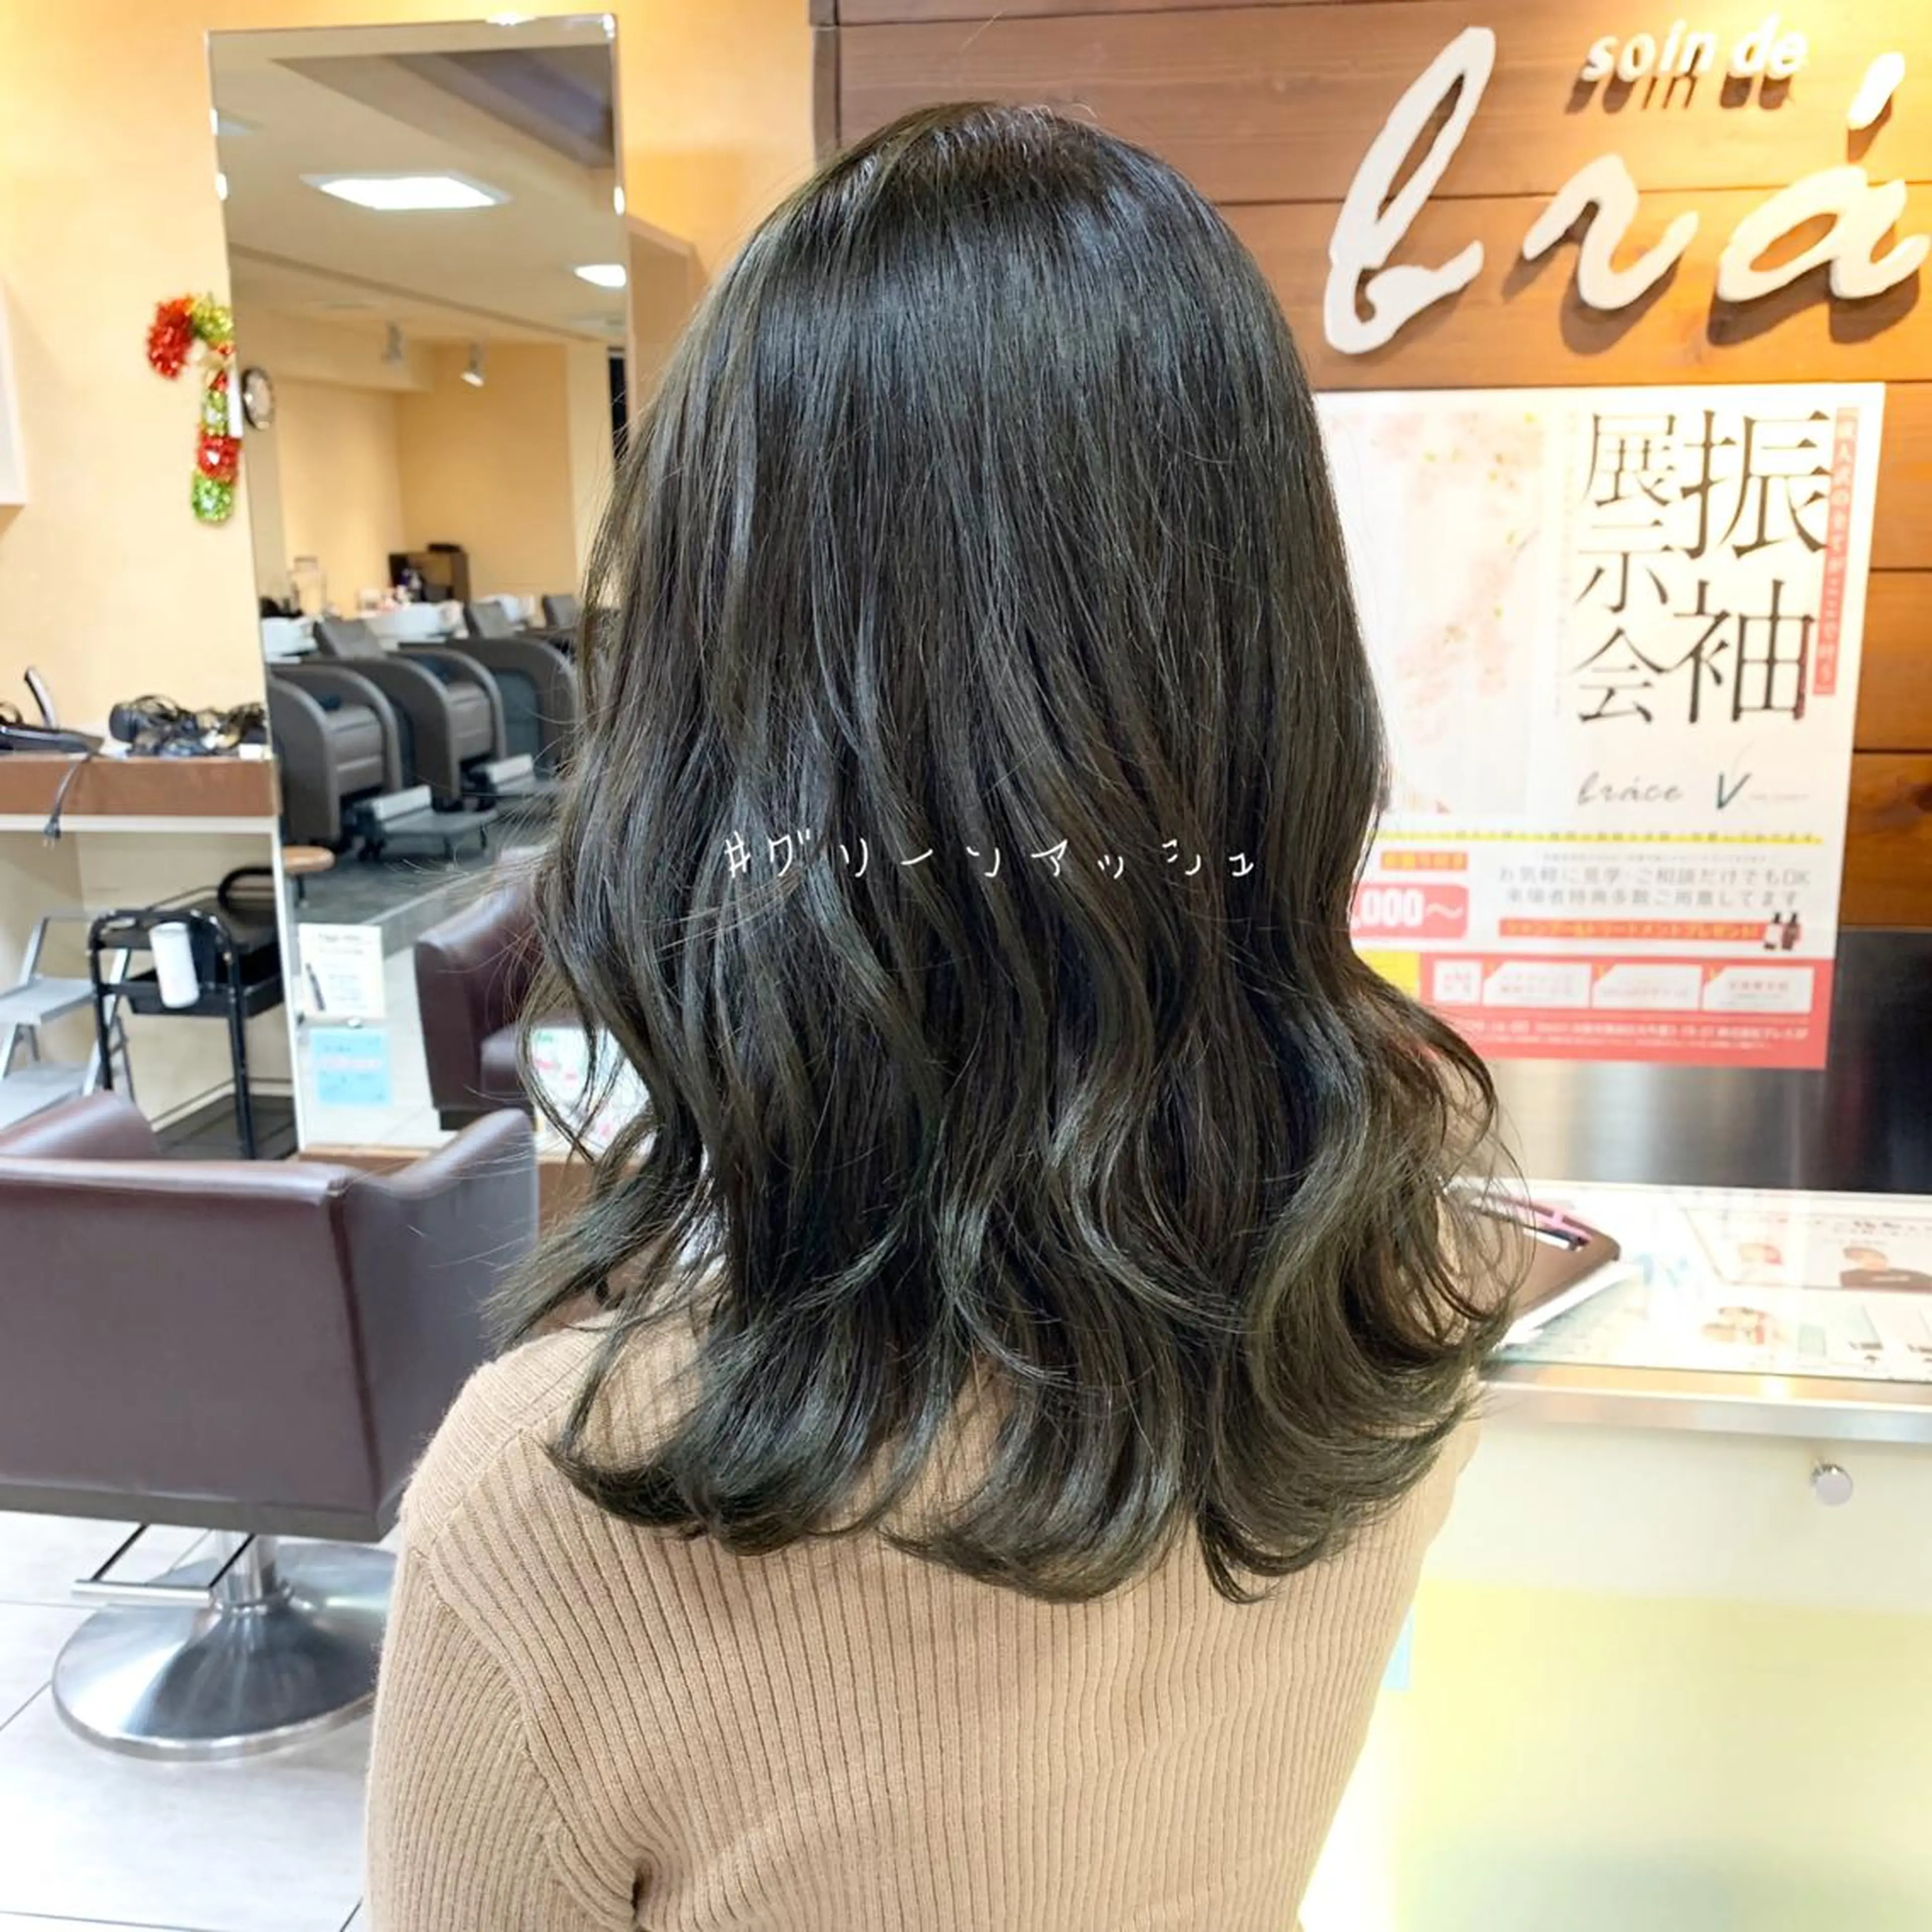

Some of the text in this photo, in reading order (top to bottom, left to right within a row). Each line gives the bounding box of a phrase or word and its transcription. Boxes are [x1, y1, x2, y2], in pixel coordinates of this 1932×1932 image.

[1582, 12, 1809, 83] soin de
[1573, 413, 1675, 725] 展示会
[1673, 409, 1834, 725] 振袖
